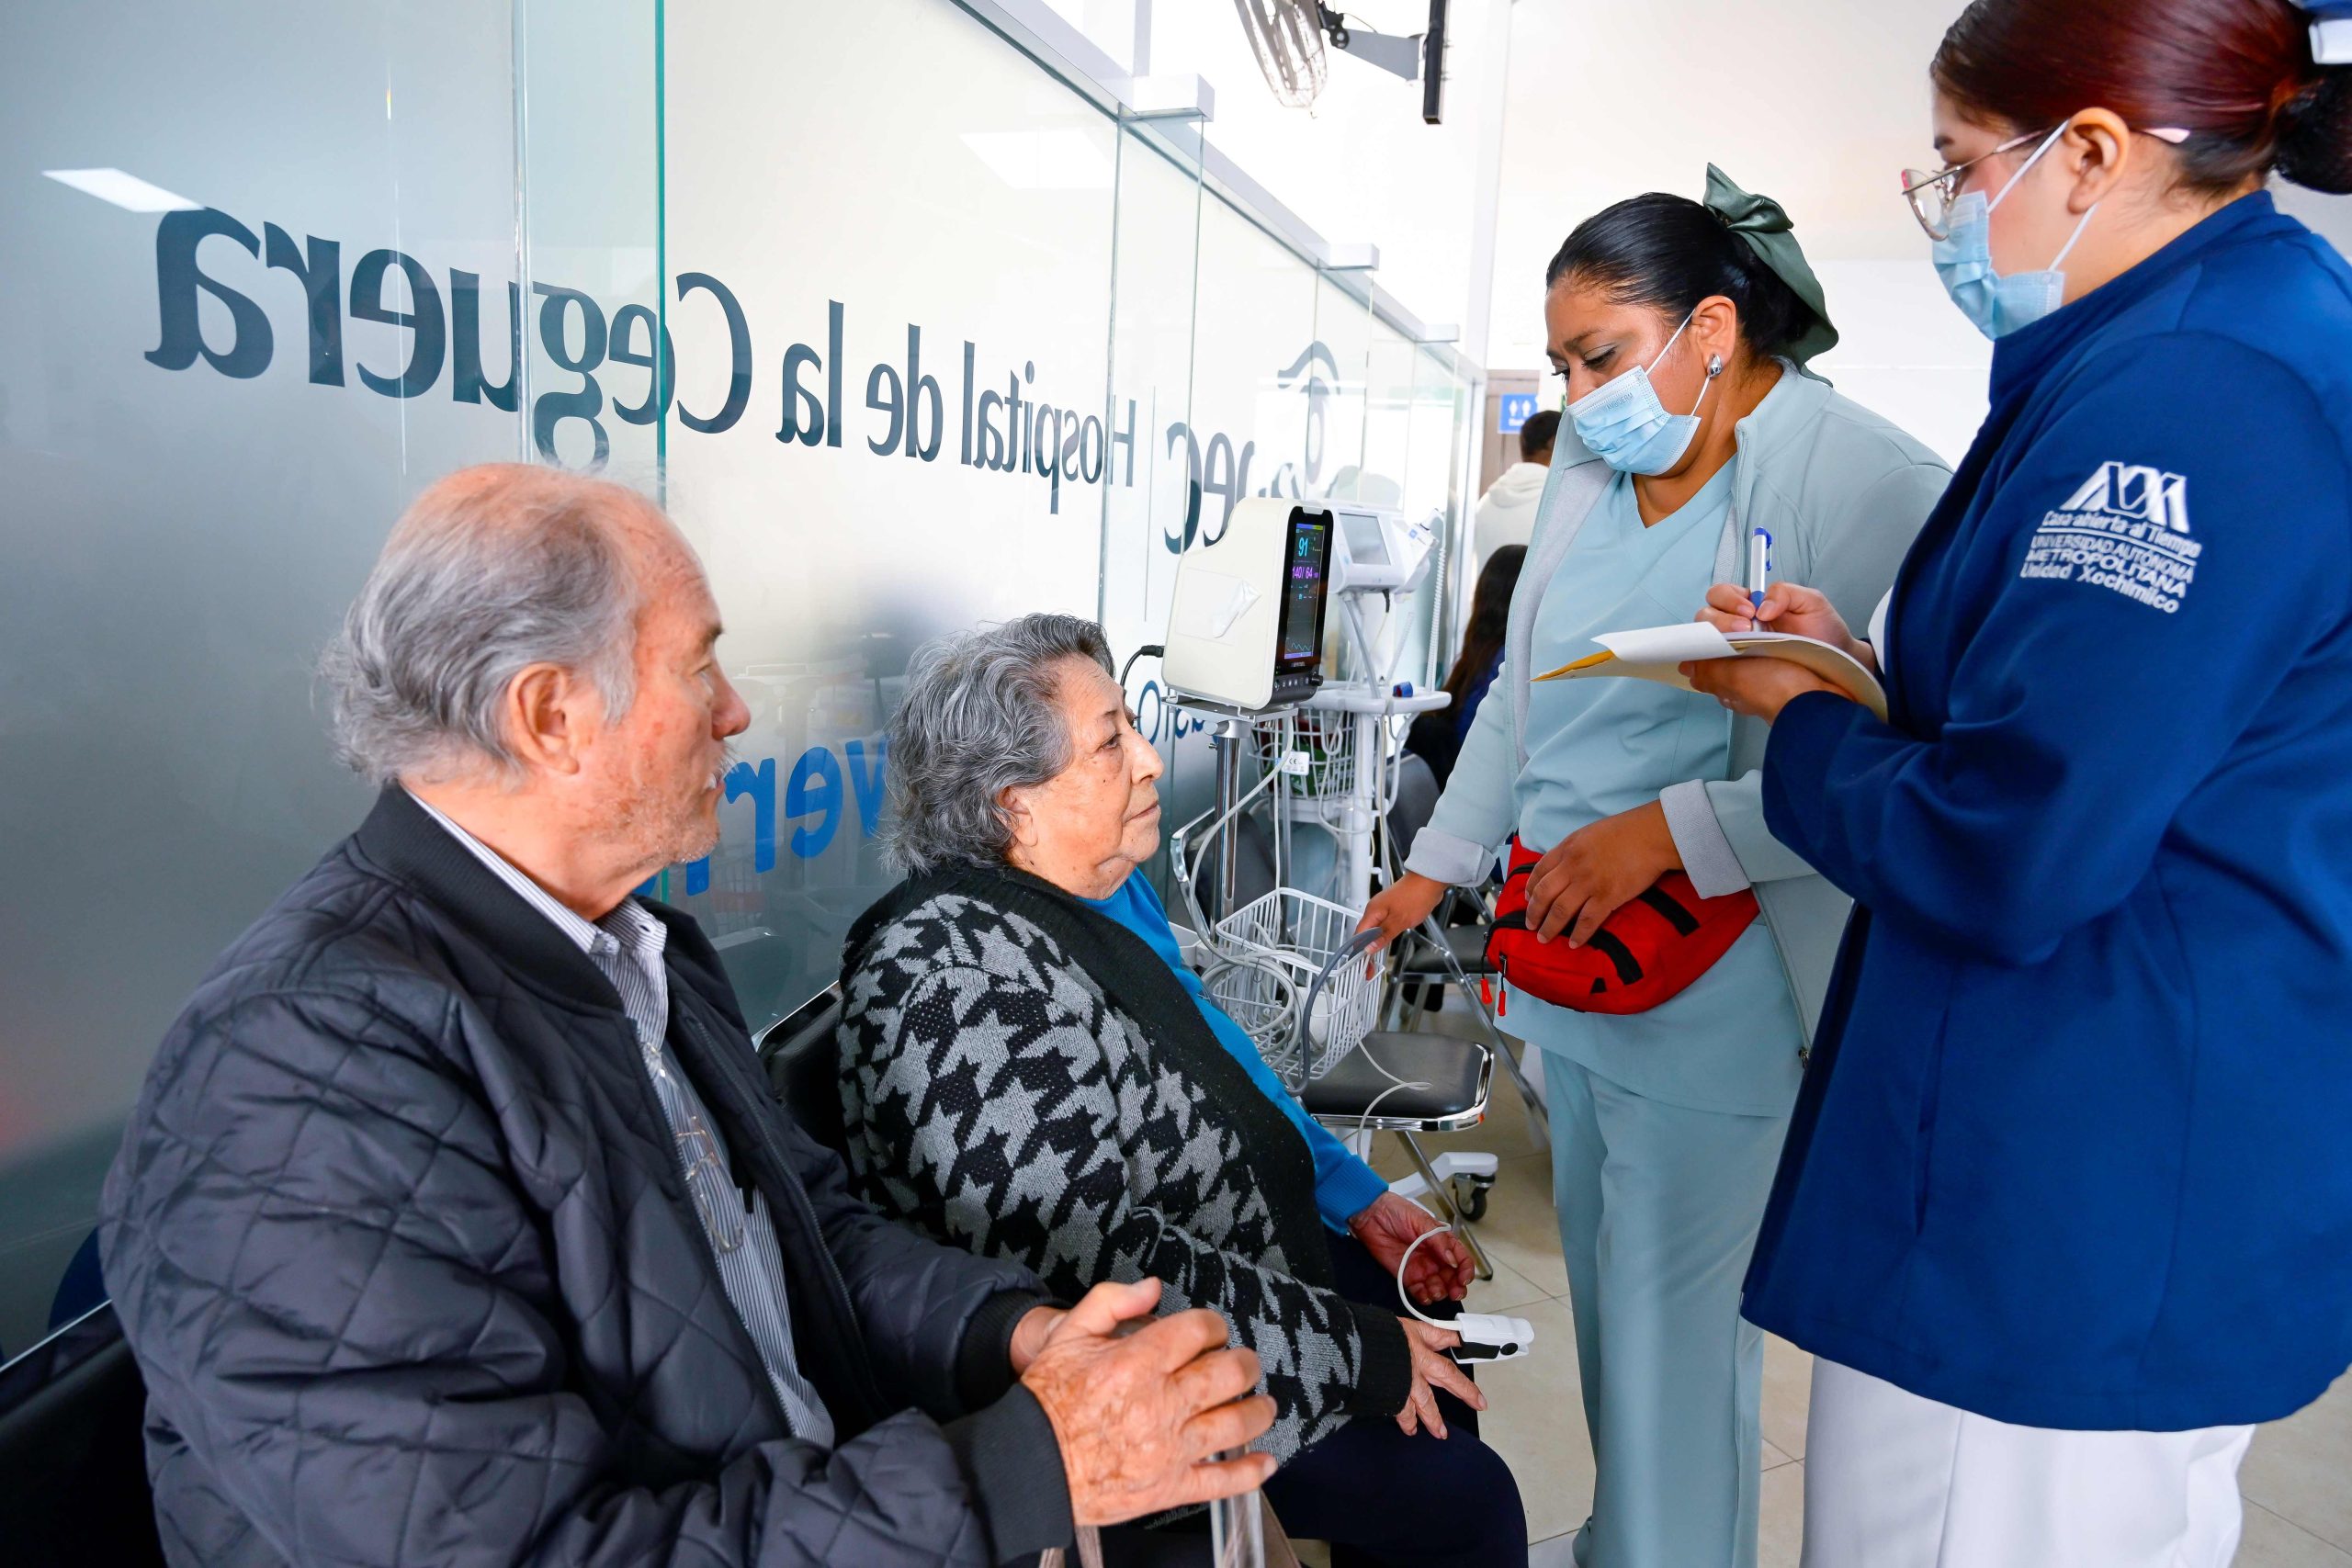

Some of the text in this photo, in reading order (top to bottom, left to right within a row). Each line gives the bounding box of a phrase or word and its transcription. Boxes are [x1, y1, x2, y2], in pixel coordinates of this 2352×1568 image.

[1298, 536, 1308, 557] 91
[2030, 535, 2116, 554] UNIVERSIDAD
[2025, 547, 2187, 599] METROPOLITANA
[2075, 564, 2180, 614] Xochimilco
